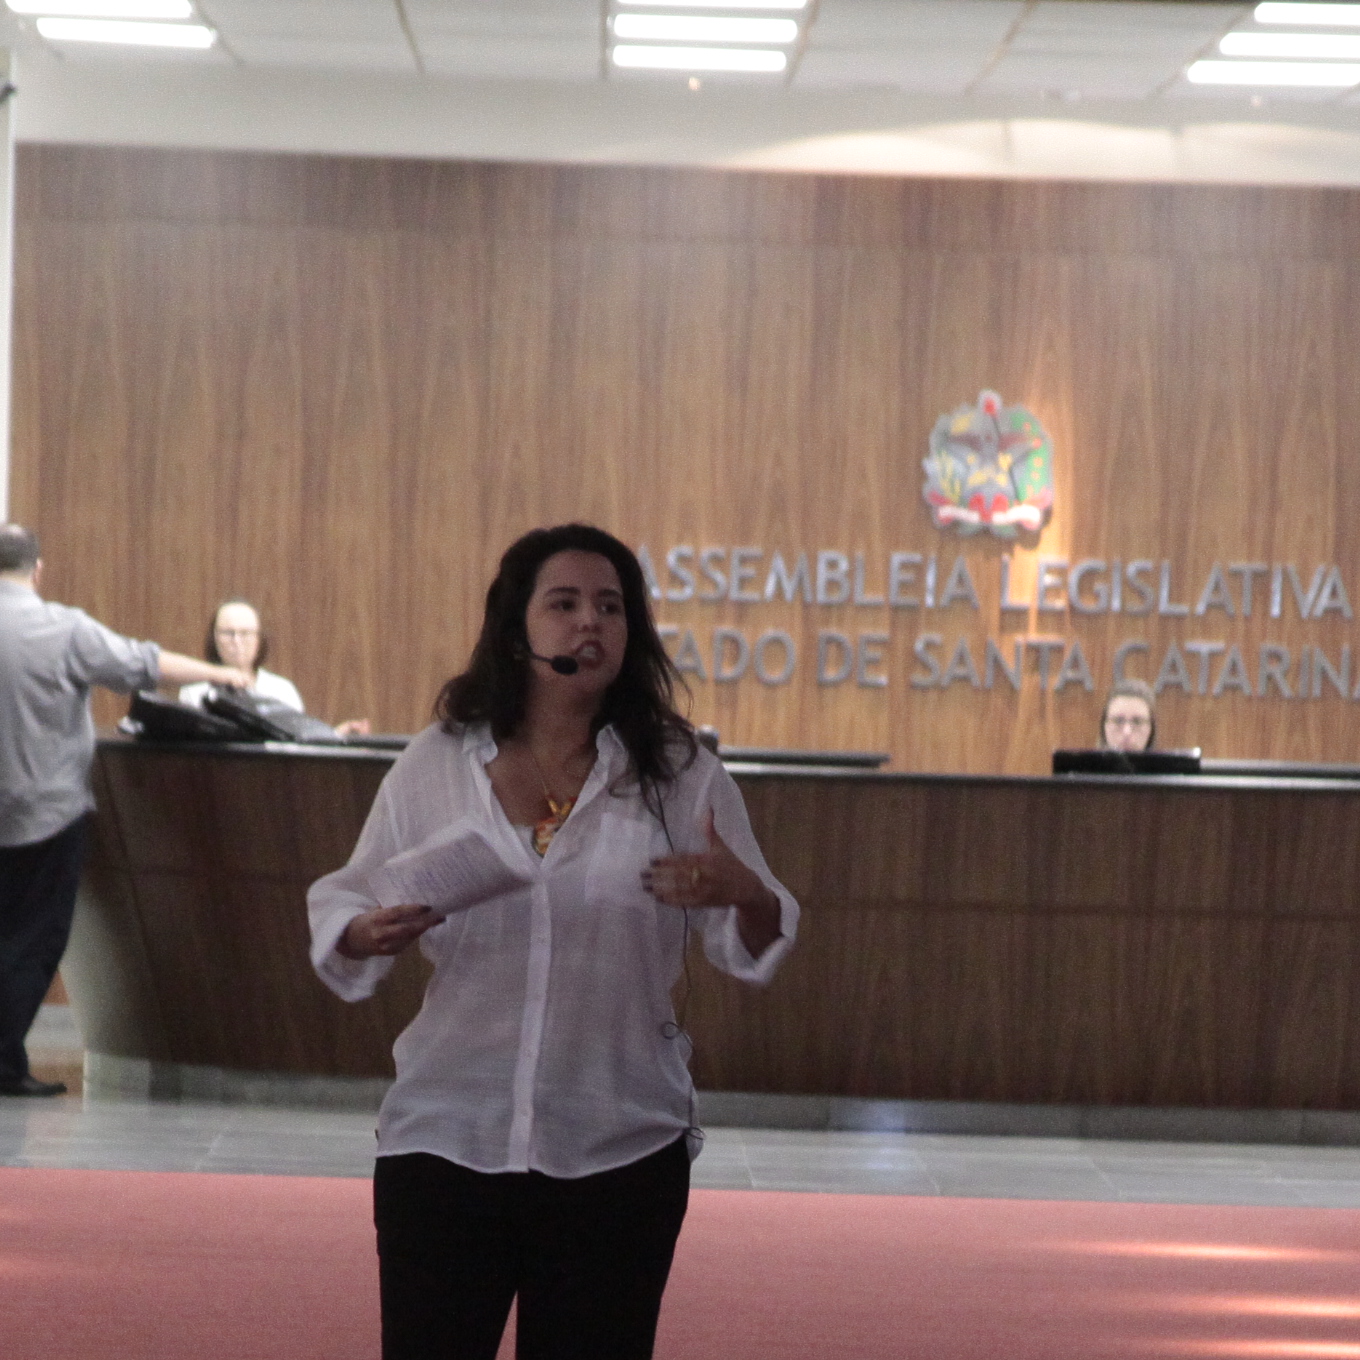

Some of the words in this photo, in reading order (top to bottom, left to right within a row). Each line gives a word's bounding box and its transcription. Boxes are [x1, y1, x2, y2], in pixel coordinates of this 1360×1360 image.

[1000, 552, 1354, 620] LEGISLATIVA
[815, 628, 891, 689] DE
[908, 632, 1095, 692] SANTA
